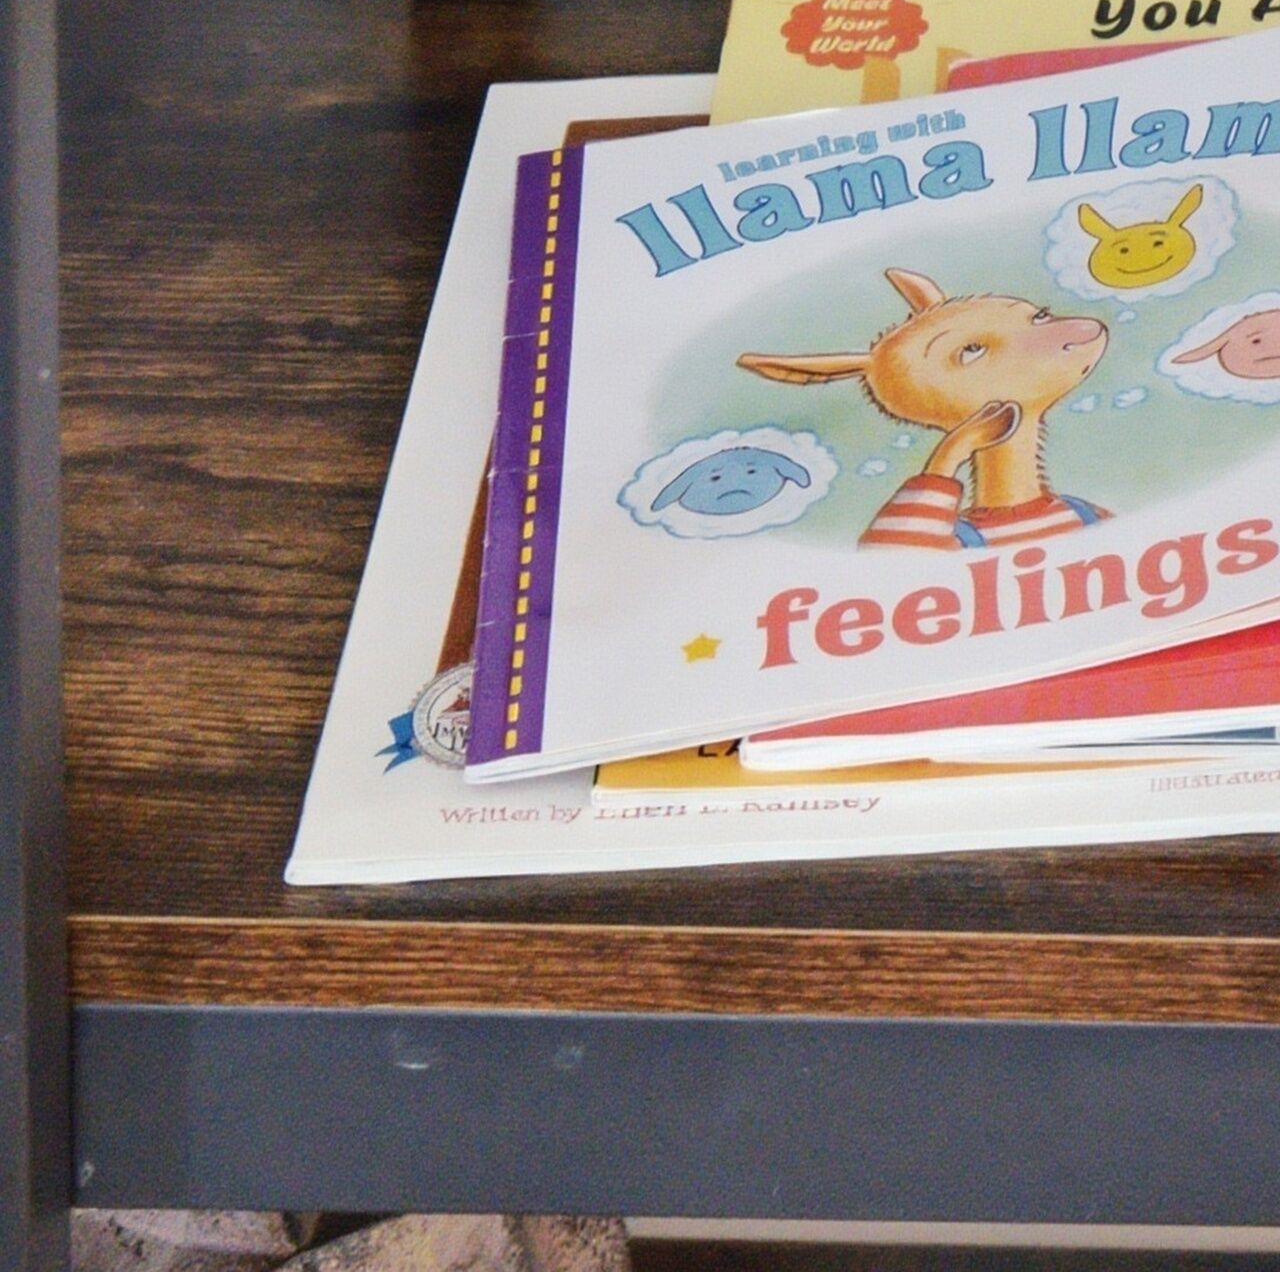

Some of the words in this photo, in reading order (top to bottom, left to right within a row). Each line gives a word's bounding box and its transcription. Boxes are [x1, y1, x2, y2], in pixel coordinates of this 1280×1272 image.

[809, 34, 897, 54] World
[820, 15, 889, 32] Your
[717, 129, 879, 182] learning
[887, 108, 967, 142] with
[615, 139, 994, 278] llama
[757, 518, 1280, 670] feelings
[440, 806, 540, 824] Written
[550, 804, 583, 824] by
